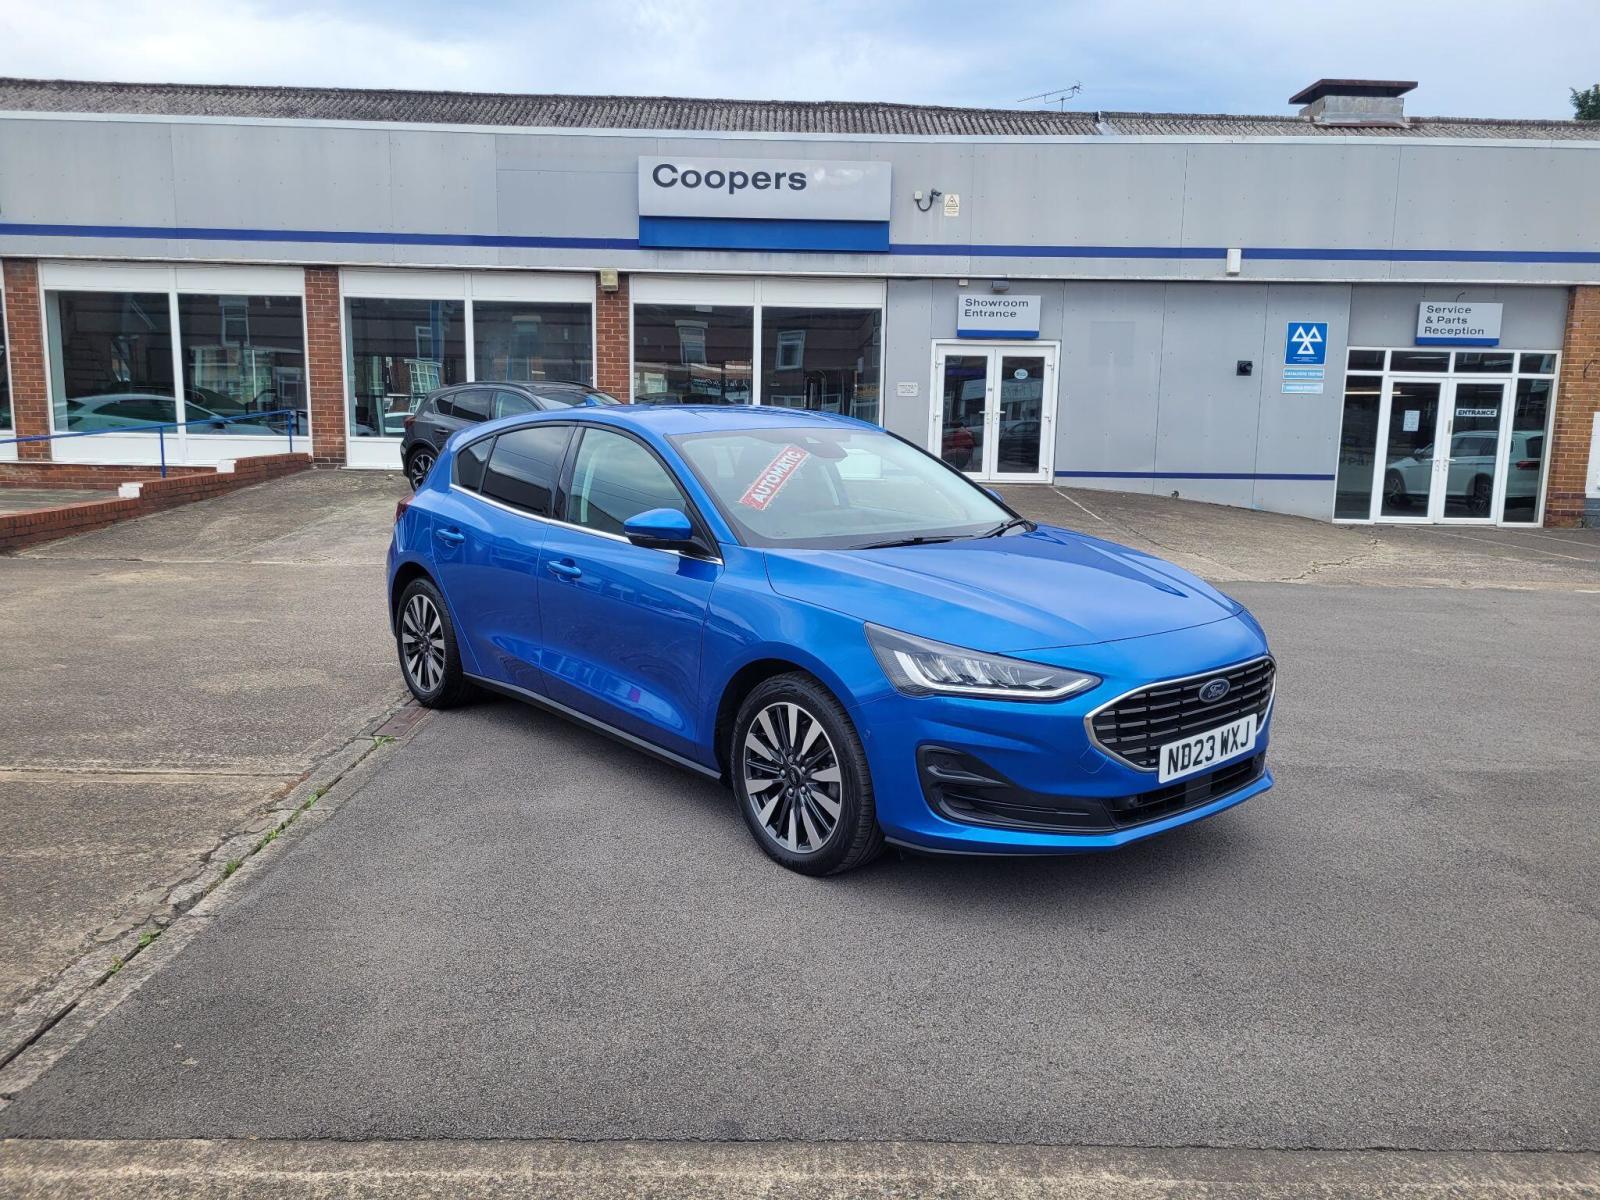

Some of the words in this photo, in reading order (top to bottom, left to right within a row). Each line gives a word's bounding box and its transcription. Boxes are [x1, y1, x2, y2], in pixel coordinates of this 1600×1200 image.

[652, 163, 807, 195] Coopers
[965, 298, 1029, 308] Showroom
[964, 308, 1017, 318] Entrance
[1426, 305, 1472, 314] Service
[1425, 315, 1434, 324] &
[1437, 316, 1468, 325] Parts
[1424, 326, 1485, 336] Reception
[750, 450, 802, 504] AUTOMATIC
[1167, 735, 1216, 776] ND23
[1220, 720, 1250, 757] WXJ
